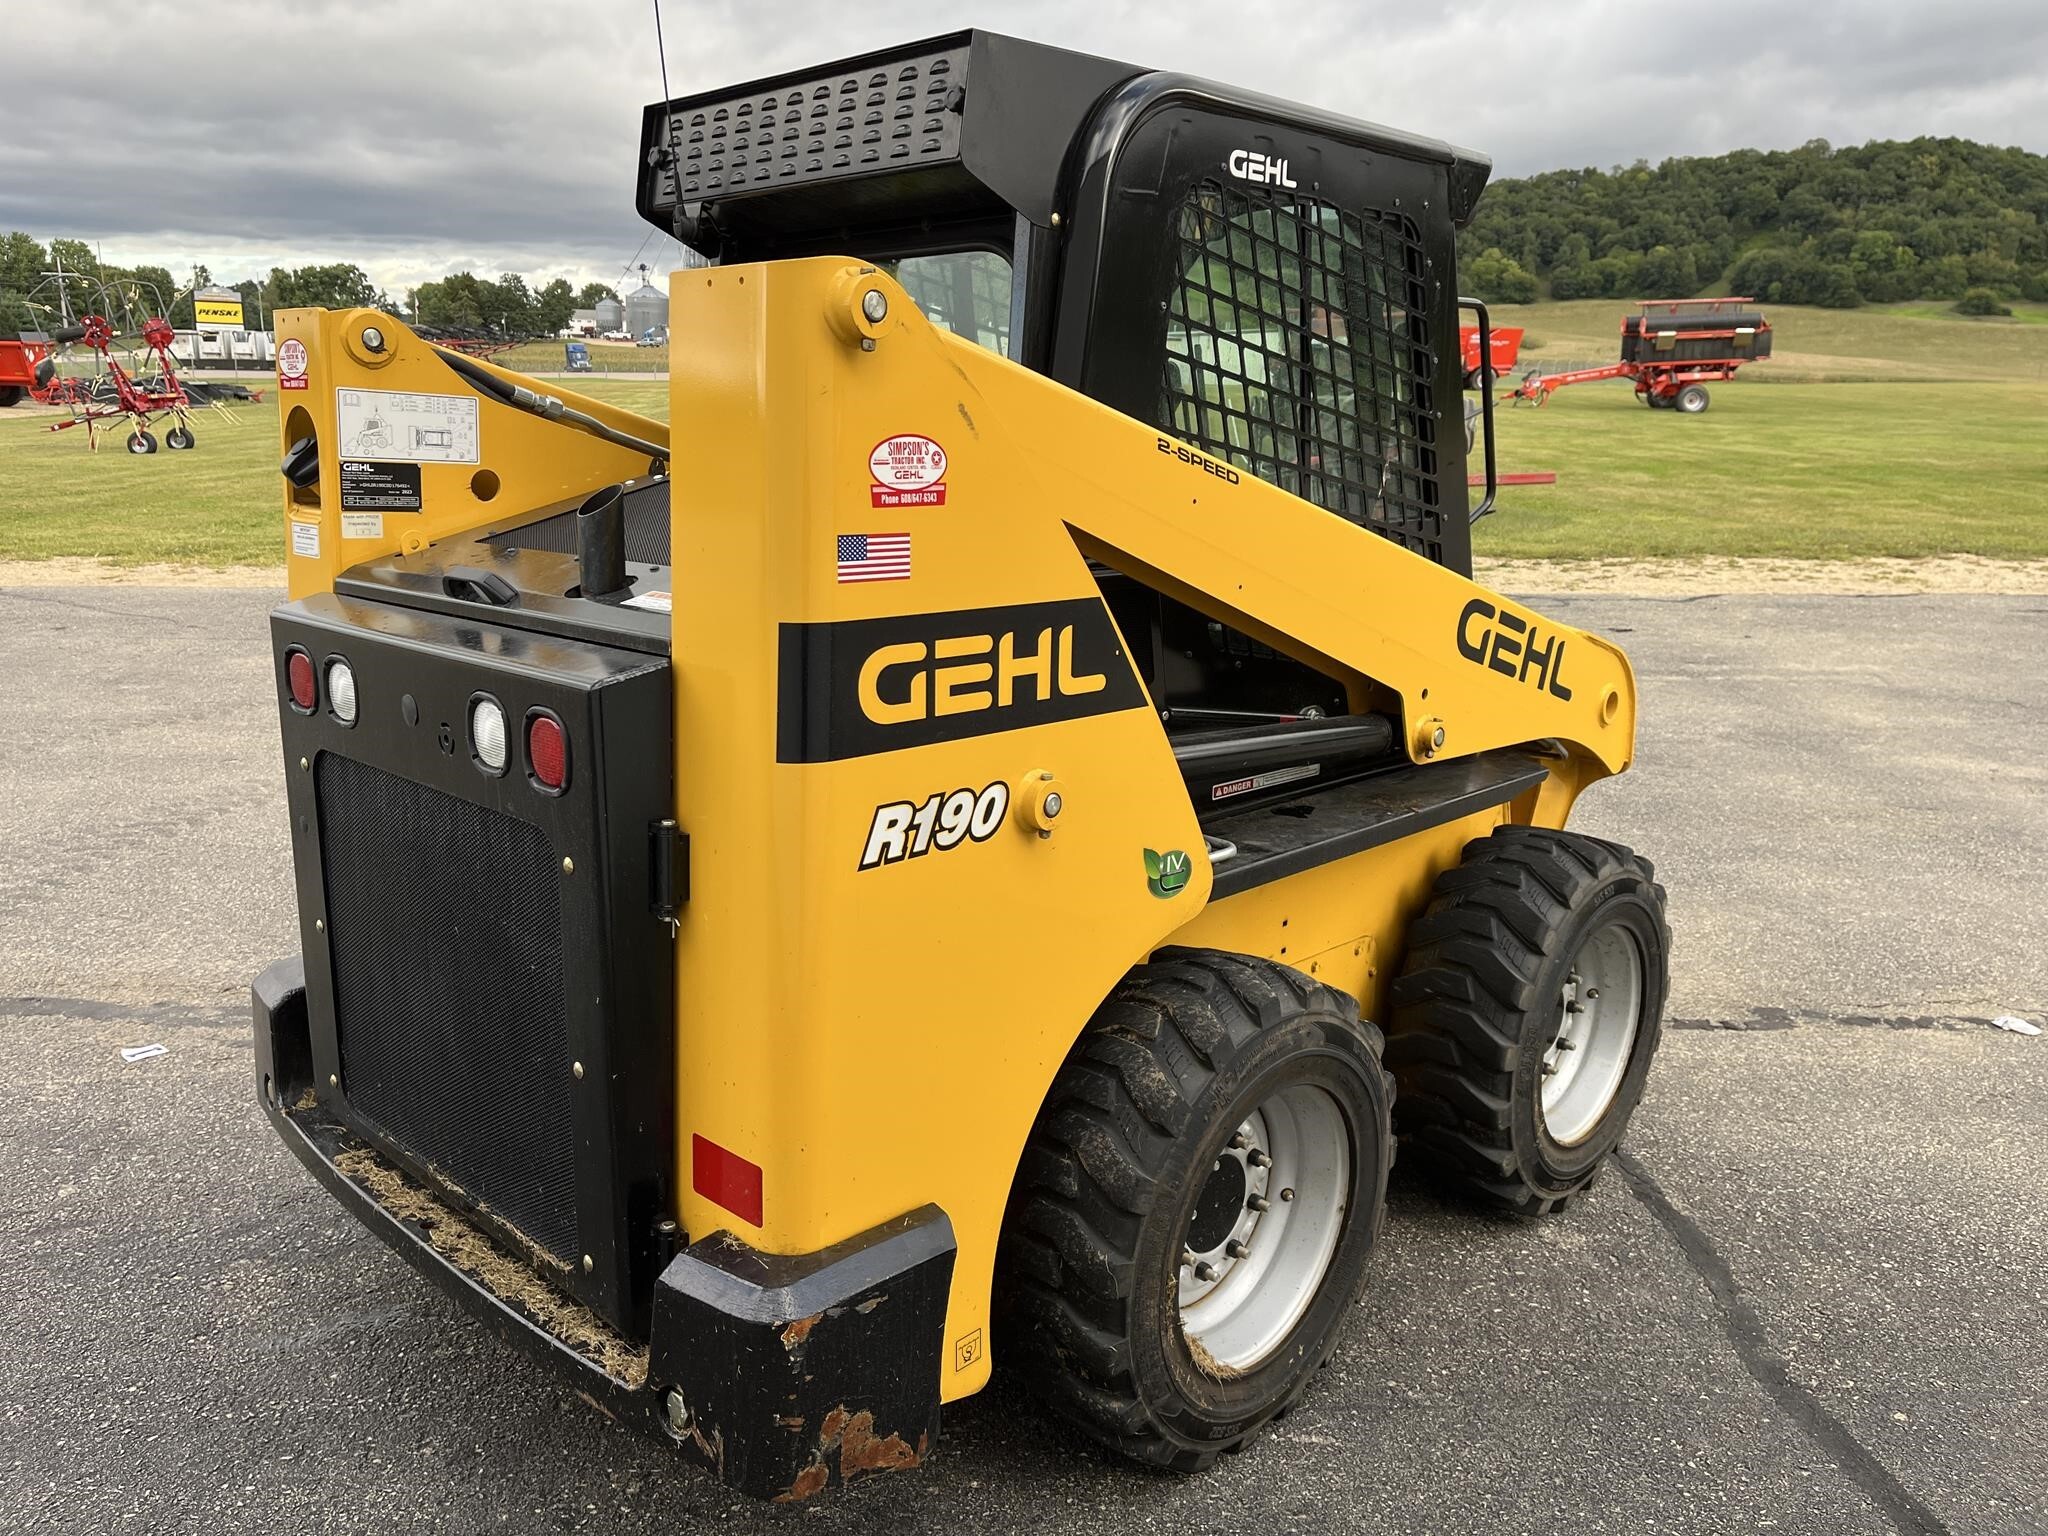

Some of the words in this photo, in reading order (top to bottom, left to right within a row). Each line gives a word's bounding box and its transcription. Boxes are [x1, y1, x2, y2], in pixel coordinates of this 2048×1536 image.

[1229, 149, 1298, 189] GEHL
[198, 308, 240, 317] PENSKE
[888, 441, 929, 456] SIMPSON'S
[342, 462, 375, 472] GEHL
[892, 457, 914, 465] TRACTOR
[915, 456, 927, 465] INC.
[1158, 437, 1240, 485] 2-SPEED
[894, 470, 924, 480] GEHL
[881, 493, 899, 505] Phone
[1456, 598, 1573, 702] GEHL
[858, 624, 1107, 725] GEHL
[1222, 780, 1252, 795] DANGER
[857, 780, 1010, 872] R190
